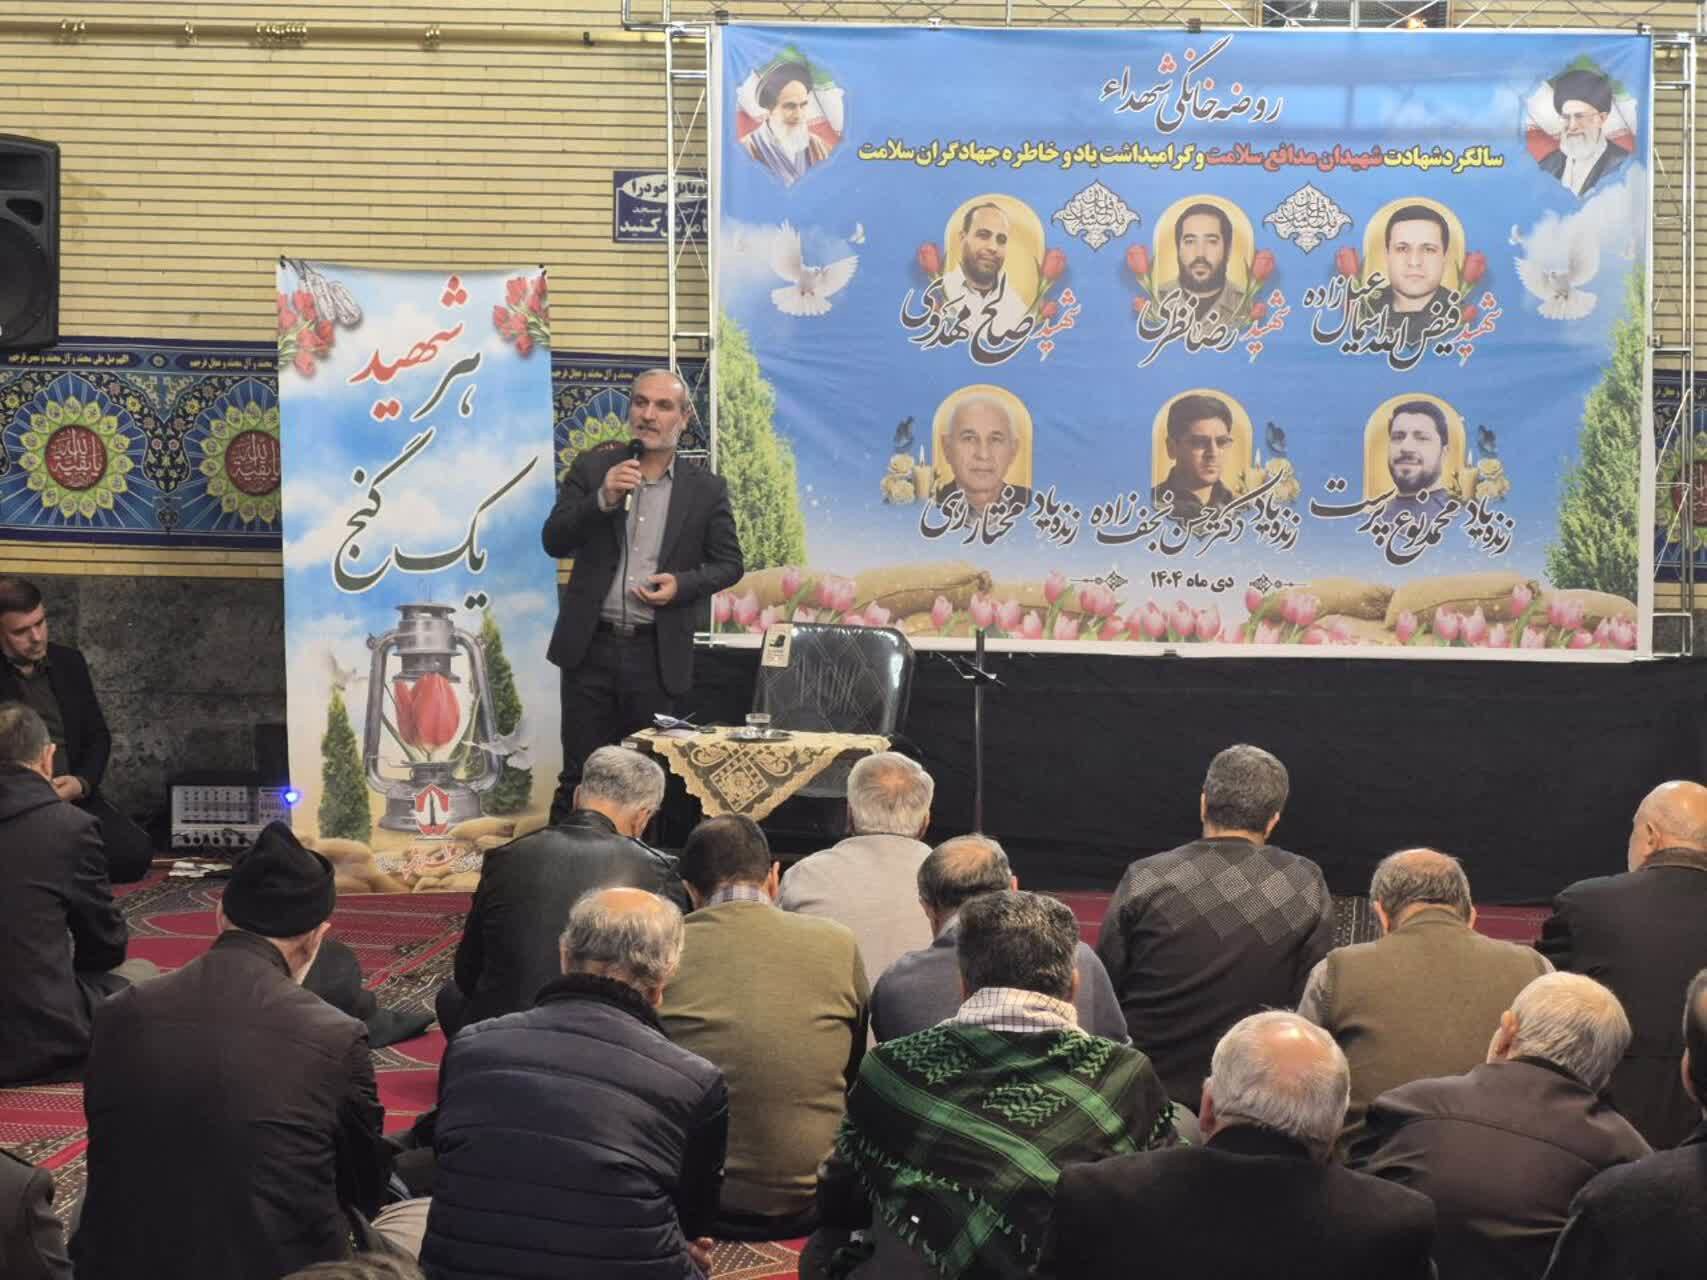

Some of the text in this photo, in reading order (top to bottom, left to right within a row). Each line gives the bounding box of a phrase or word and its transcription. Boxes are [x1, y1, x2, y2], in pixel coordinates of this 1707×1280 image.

[1155, 34, 1233, 134] خانگی
[1211, 82, 1284, 123] روضه
[857, 137, 1505, 174] سالگرد شهادت شهیدان مدافع سلامت و گرامیداشت یاد و خاطره جهادگران سلامت
[901, 271, 1082, 367] شهید صالح مهدوی
[1136, 288, 1291, 368] شهید رضا نظری
[1388, 289, 1461, 371] فیض
[1454, 291, 1503, 367] شهید
[348, 274, 483, 422] هر شهید
[332, 426, 540, 611] یک گنج
[1028, 485, 1061, 532] یاد
[1048, 502, 1082, 549] زنده
[1159, 505, 1217, 556] حسن
[1195, 468, 1285, 558] دکتر
[1249, 494, 1280, 540] یاد
[1269, 508, 1302, 550] زنده
[1310, 477, 1399, 546] پرست
[1415, 500, 1462, 546] محمد
[1463, 496, 1494, 544] یاد
[1481, 512, 1516, 557] زنده
[1150, 570, 1235, 593] دی ماه ۱۴۰۴
